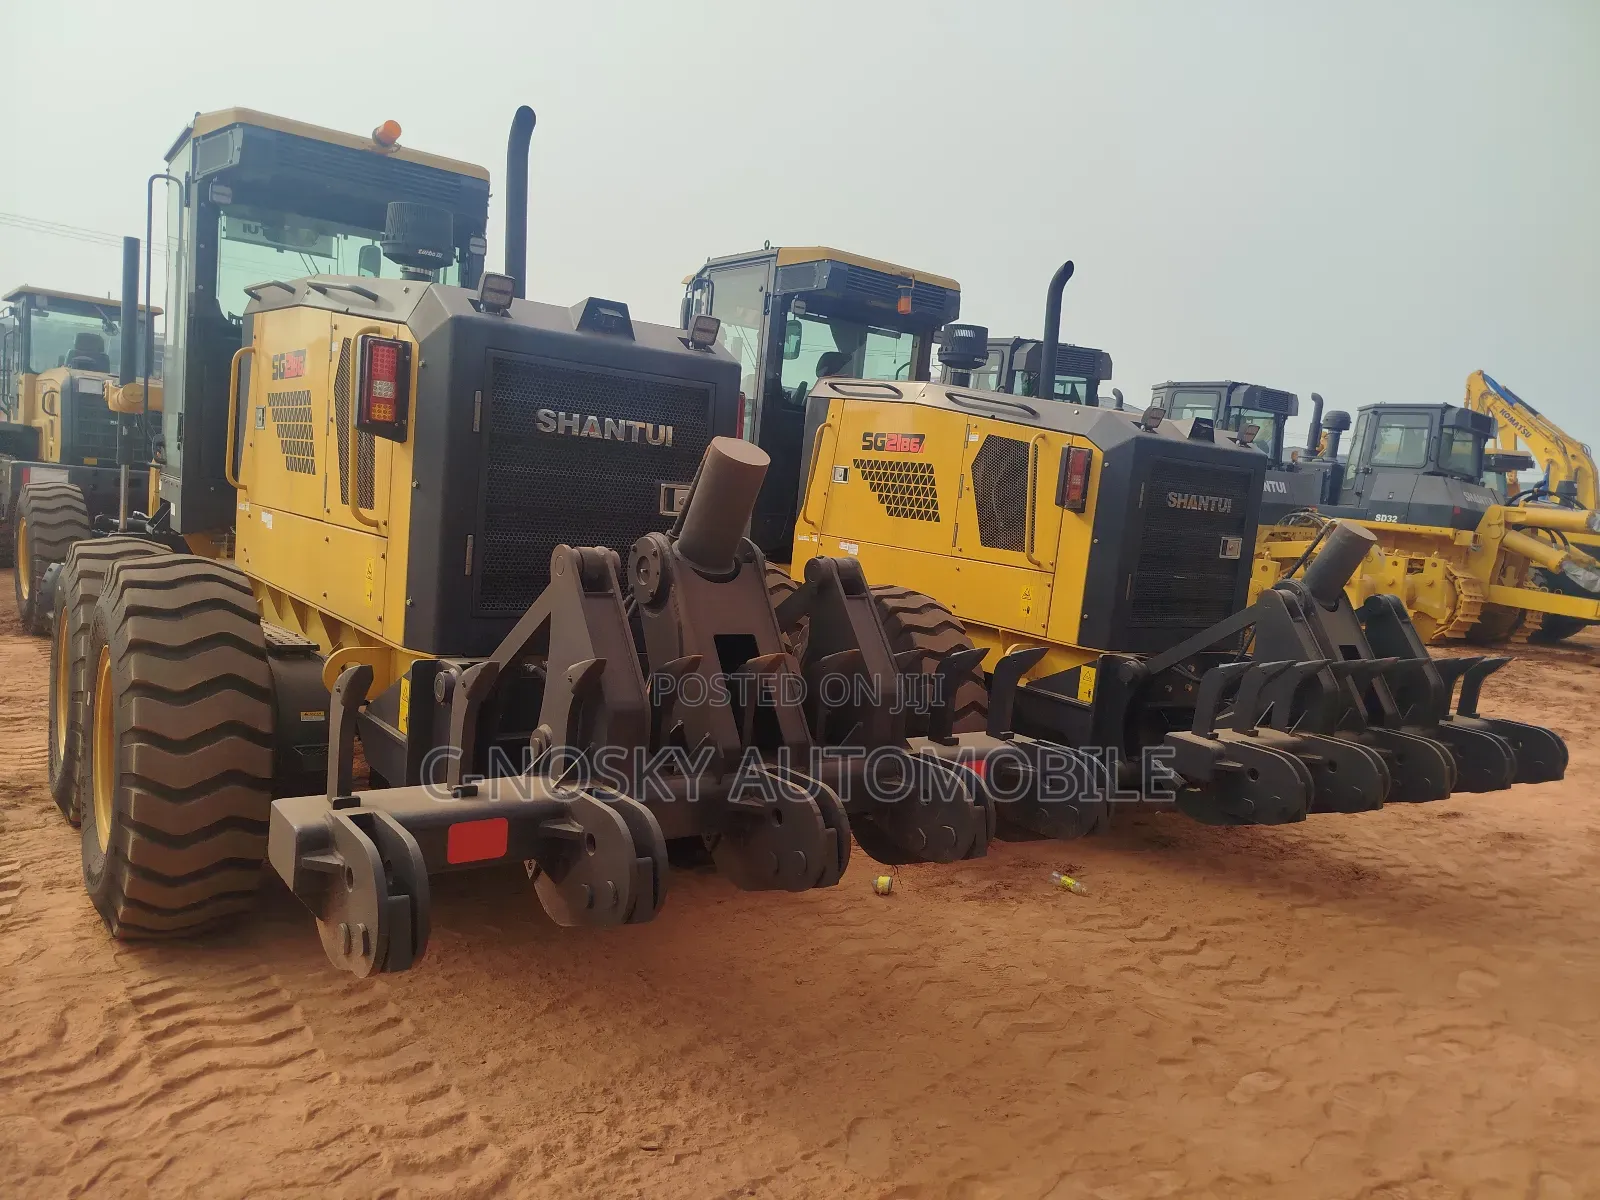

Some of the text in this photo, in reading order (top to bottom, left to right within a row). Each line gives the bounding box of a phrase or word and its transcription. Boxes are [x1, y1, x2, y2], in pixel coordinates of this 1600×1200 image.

[536, 408, 673, 447] SHANTUI
[1500, 408, 1532, 438] KOMATSU
[1263, 480, 1287, 494] NTUI
[1168, 491, 1232, 513] SHANTUI
[1375, 513, 1398, 523] SD32
